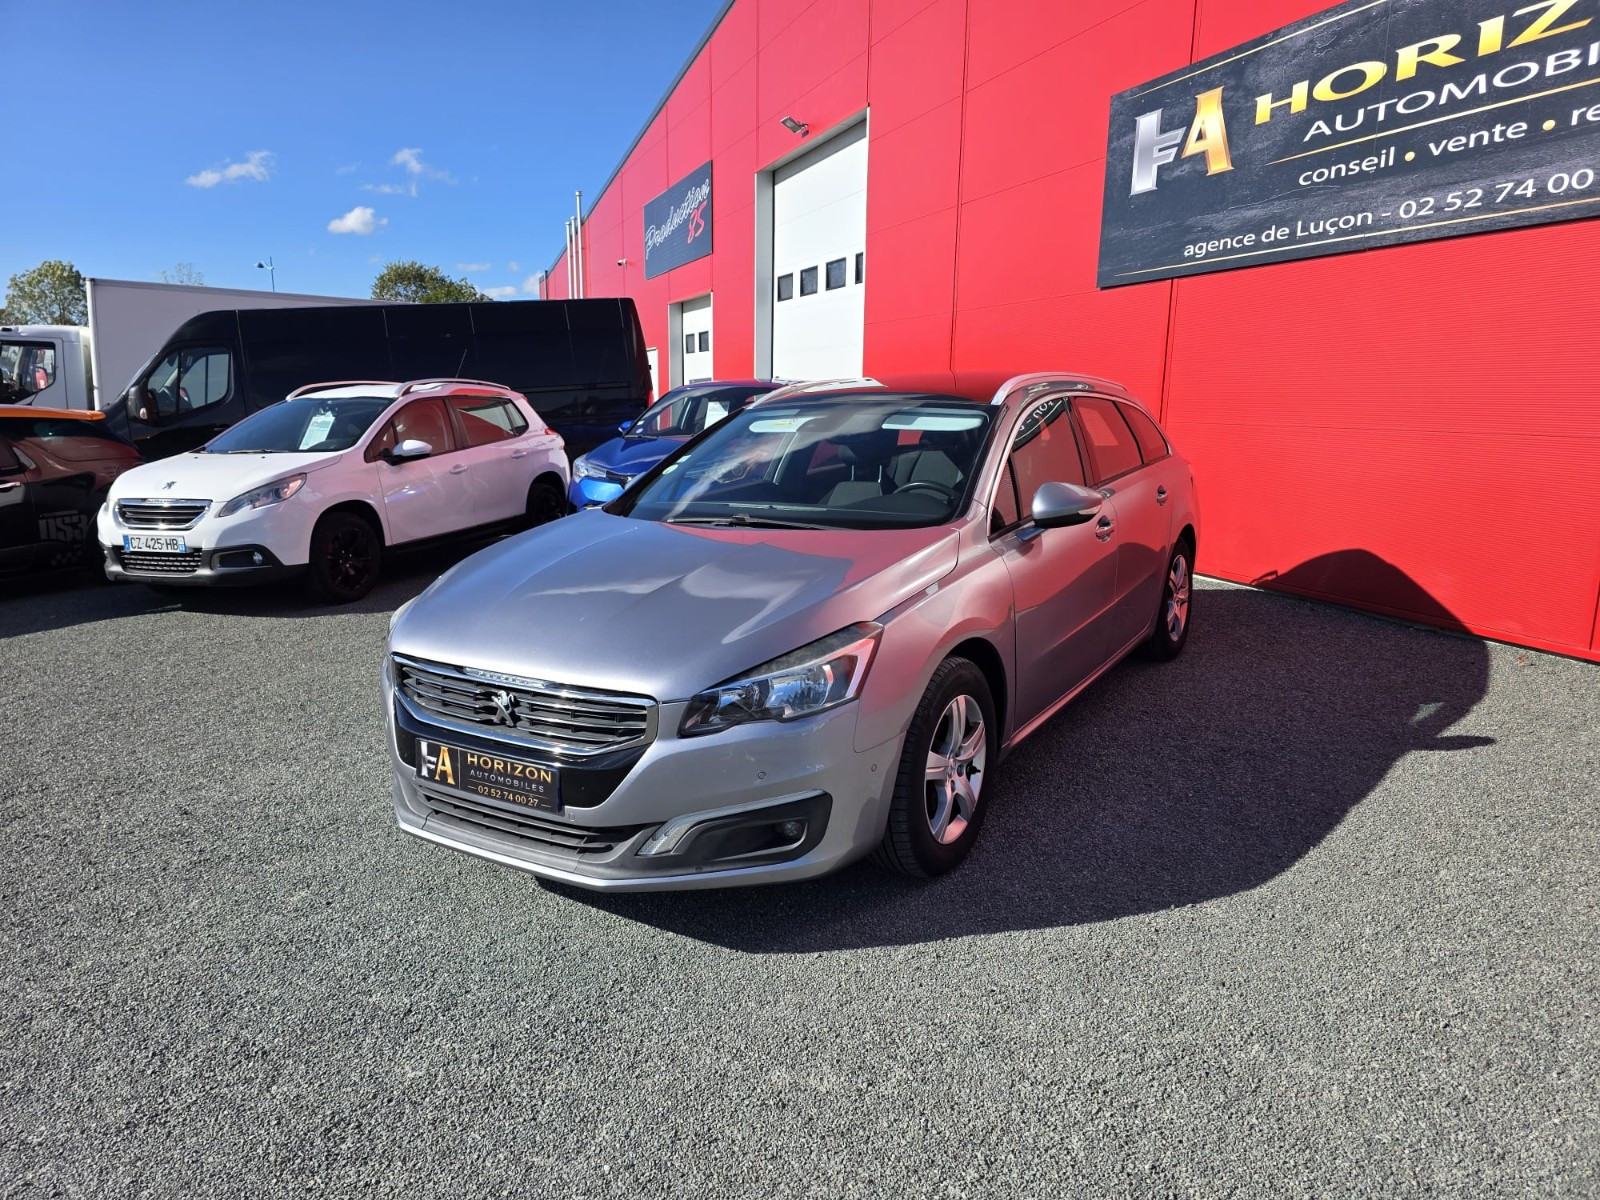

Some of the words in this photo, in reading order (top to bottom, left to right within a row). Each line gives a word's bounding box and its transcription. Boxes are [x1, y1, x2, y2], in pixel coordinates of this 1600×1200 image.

[1254, 0, 1594, 125] HORIZ
[1303, 41, 1600, 142] AUTOMOBI
[1298, 146, 1396, 186] conseil
[1428, 121, 1528, 156] vente
[1184, 232, 1256, 258] agence
[1261, 215, 1290, 243] de
[1296, 211, 1373, 235] Luçon
[1399, 197, 1435, 219] 02
[1444, 188, 1483, 212] 52
[1495, 179, 1536, 204] 74
[1547, 168, 1594, 194] 00
[467, 753, 552, 783] HORIZON
[470, 769, 544, 793] AUTOMOBILES
[477, 785, 489, 795] 02
[490, 788, 501, 798] 52
[503, 791, 514, 801] 74
[515, 795, 527, 804] 00
[528, 798, 539, 807] 27
